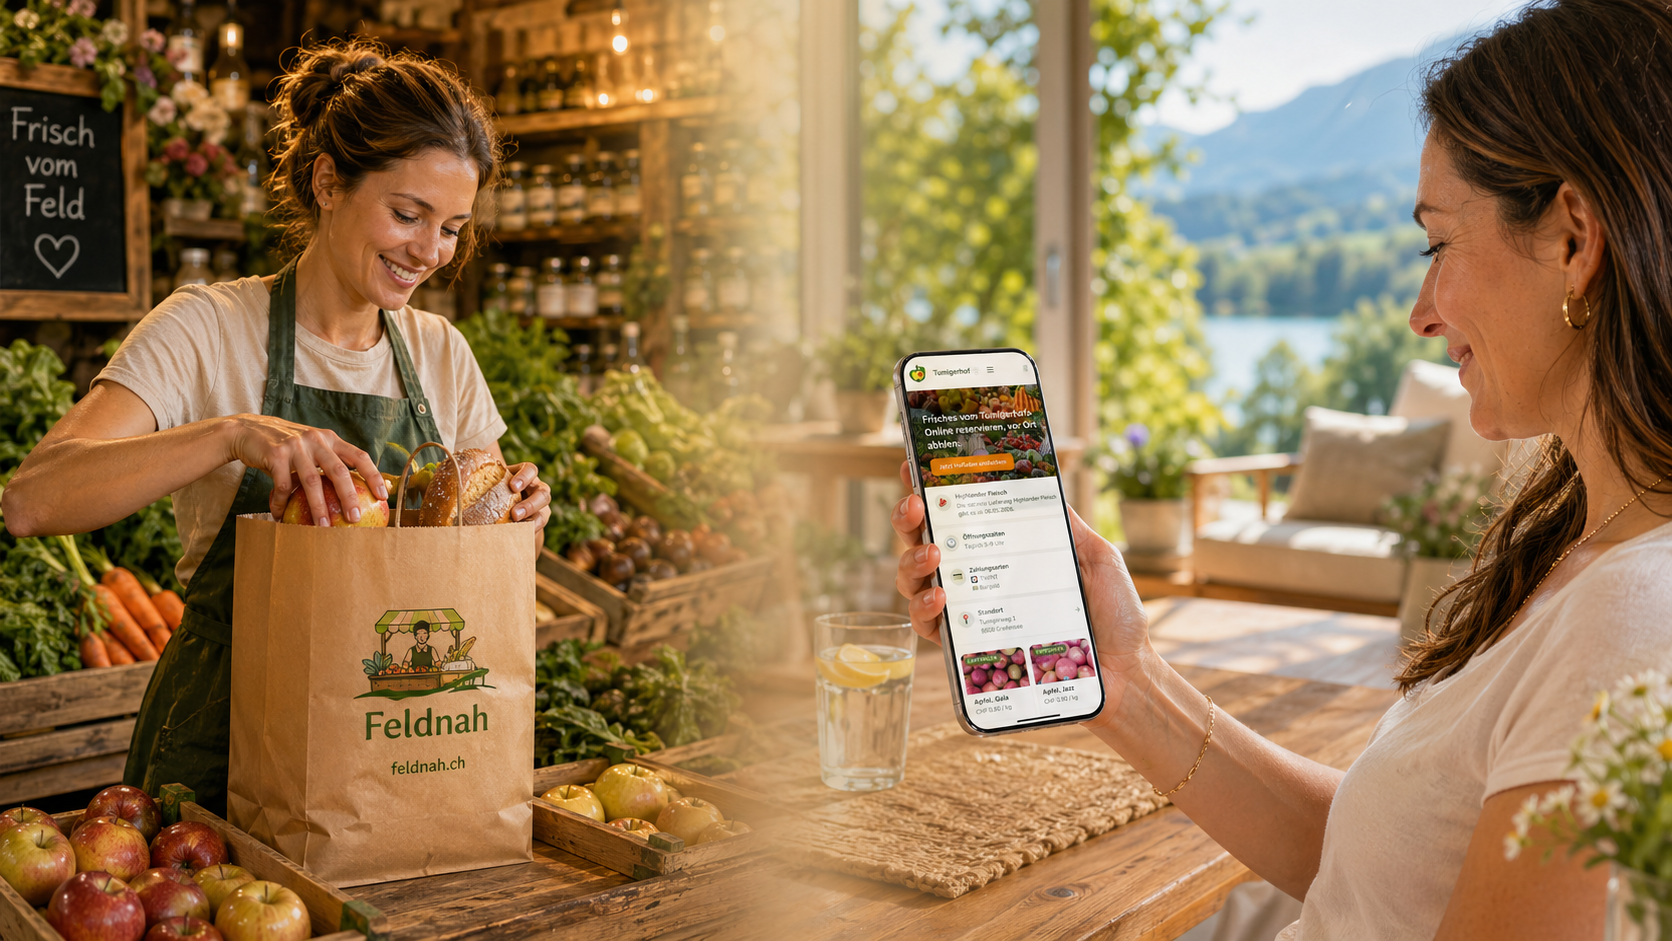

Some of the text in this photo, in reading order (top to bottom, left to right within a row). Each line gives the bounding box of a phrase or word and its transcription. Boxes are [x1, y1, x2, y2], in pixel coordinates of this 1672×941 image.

[11, 106, 95, 148] Frisch
[25, 155, 78, 178] vom
[24, 183, 86, 220] Feld
[924, 427, 954, 437] Online
[1022, 420, 1037, 429] Ort
[365, 704, 489, 741] Feldnah
[391, 756, 466, 776] feldnah.ch
